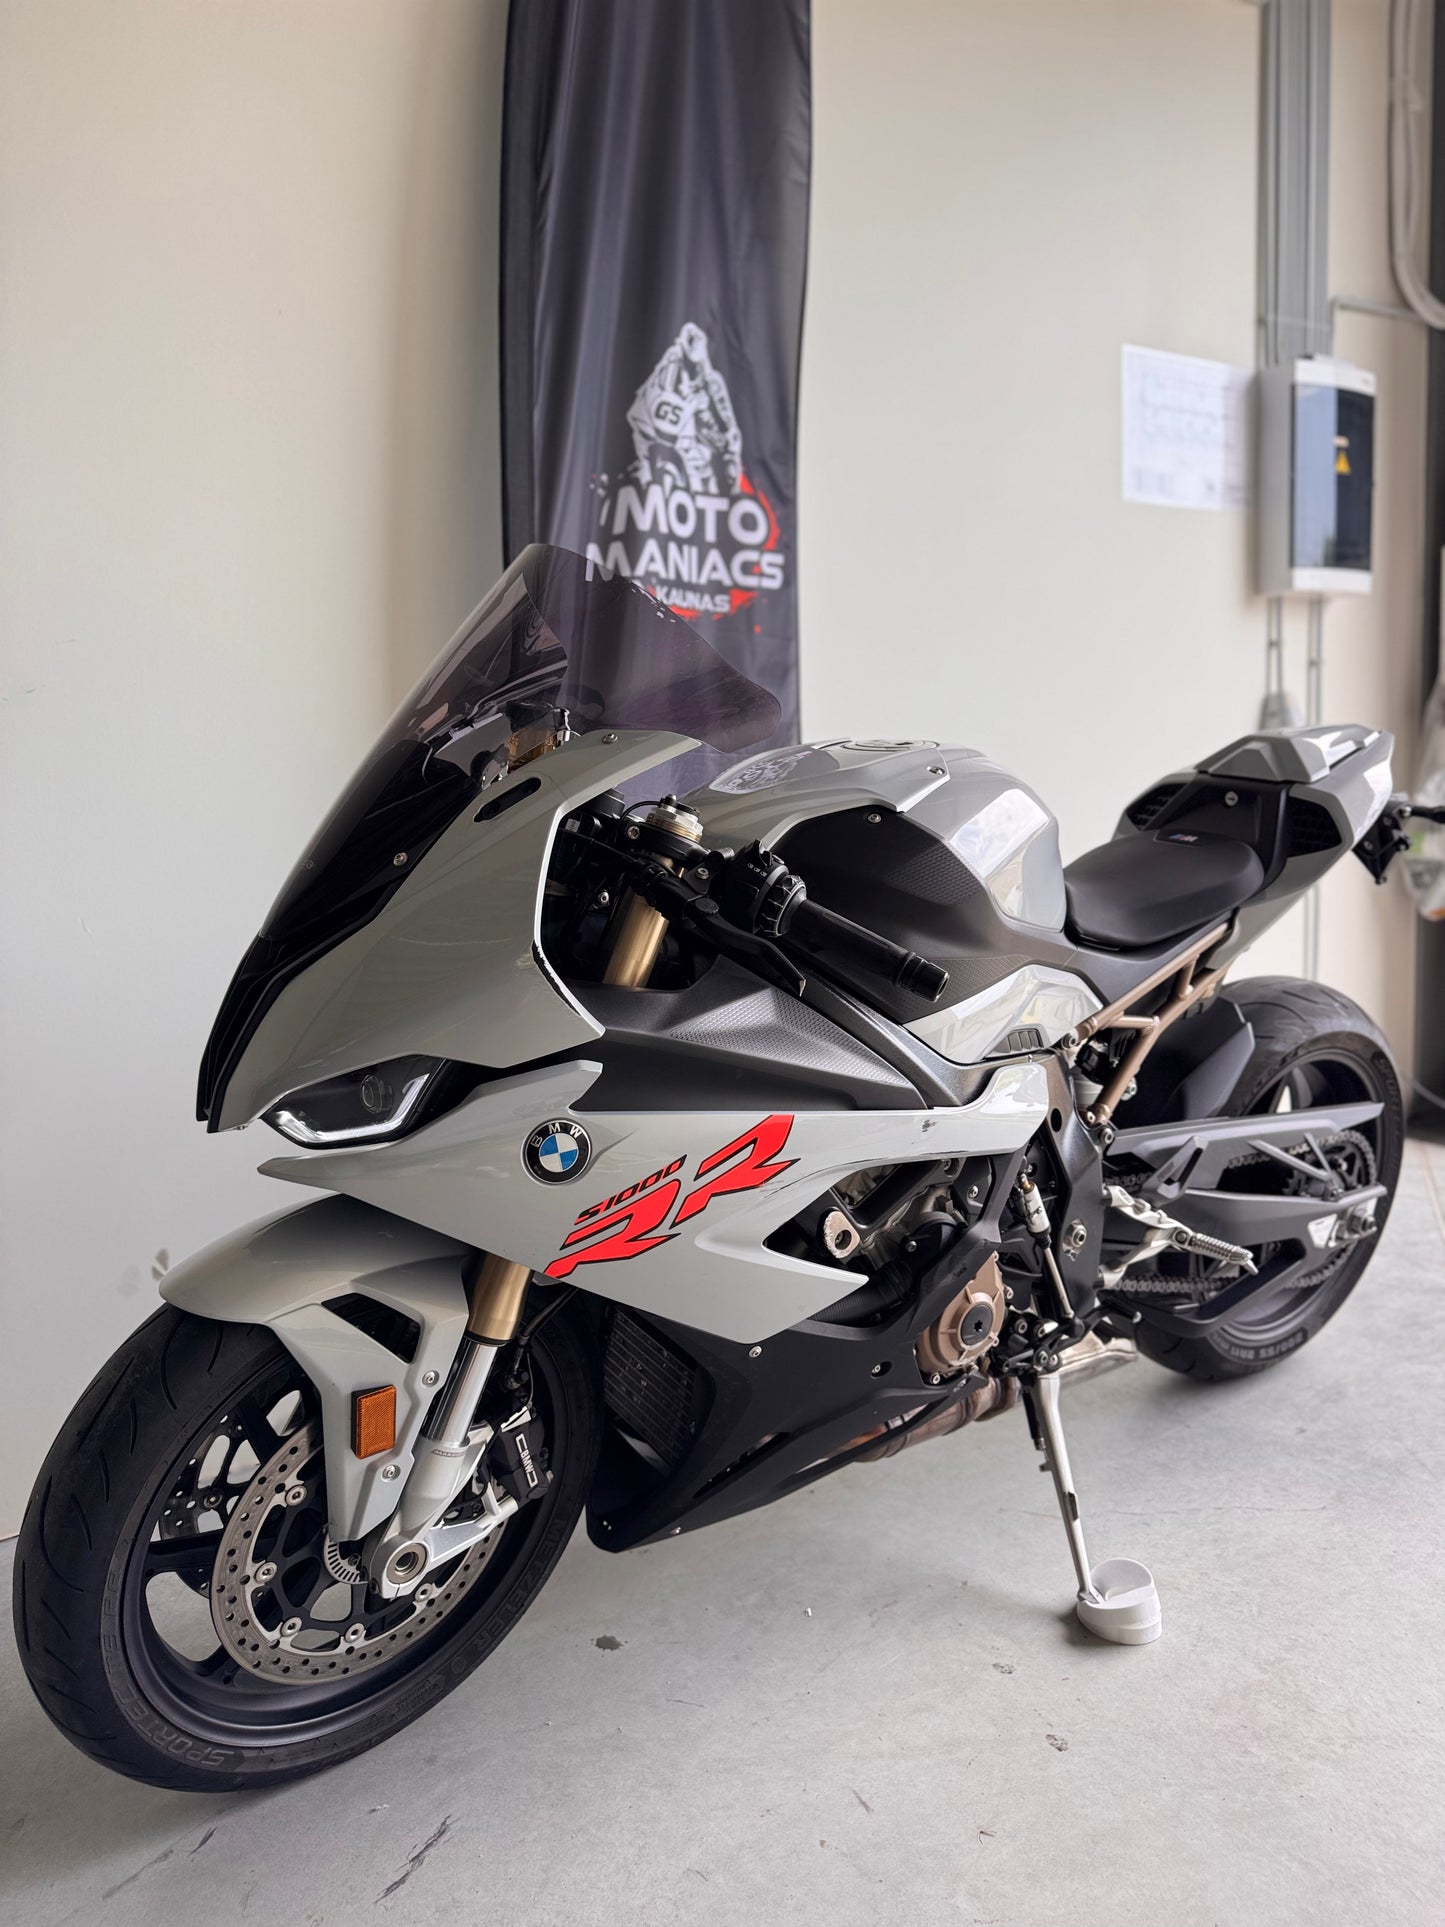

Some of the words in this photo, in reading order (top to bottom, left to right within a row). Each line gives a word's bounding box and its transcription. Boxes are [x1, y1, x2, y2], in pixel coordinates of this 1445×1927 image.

[612, 484, 769, 545] MOTO
[585, 540, 785, 590] MANIACS
[656, 584, 730, 613] KAUNAS
[530, 1122, 583, 1148] BMW
[574, 1153, 688, 1226] S1000
[520, 1448, 535, 1474] BMW
[476, 1519, 566, 1651] METZELER
[114, 1684, 235, 1767] SPORTEC
